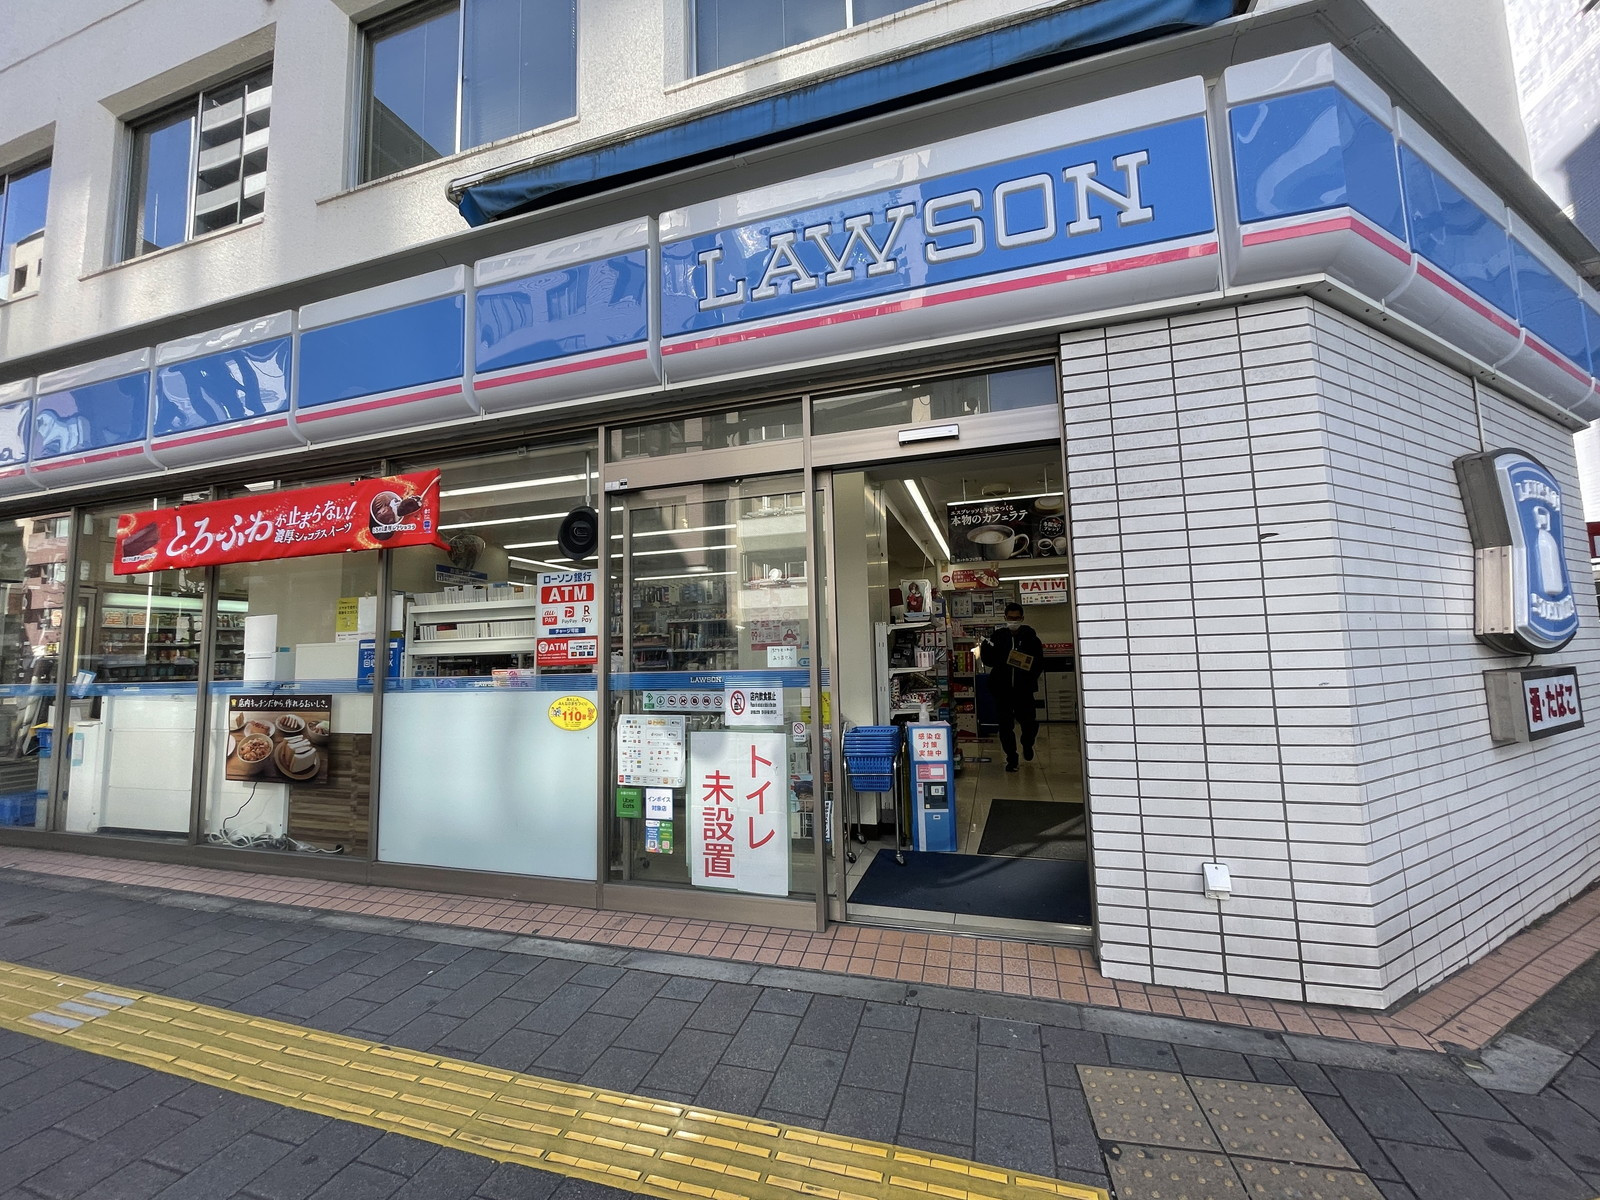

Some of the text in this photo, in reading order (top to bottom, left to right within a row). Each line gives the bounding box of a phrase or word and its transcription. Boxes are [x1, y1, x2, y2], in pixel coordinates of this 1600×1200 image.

[698, 150, 1153, 310] LAWSON
[951, 510, 1028, 526] 本物のカフェラテ
[273, 522, 352, 544] 濃厚ショコラスイーツ
[543, 572, 592, 584] ローソン銀行
[548, 585, 587, 602] ATM
[1029, 581, 1066, 592] ATM
[583, 605, 590, 615] R
[548, 642, 567, 651] ATM
[750, 691, 777, 701] 店内飲食禁止
[685, 714, 725, 725] ローソン
[746, 745, 775, 849] トイレ
[702, 770, 735, 878] 未設置
